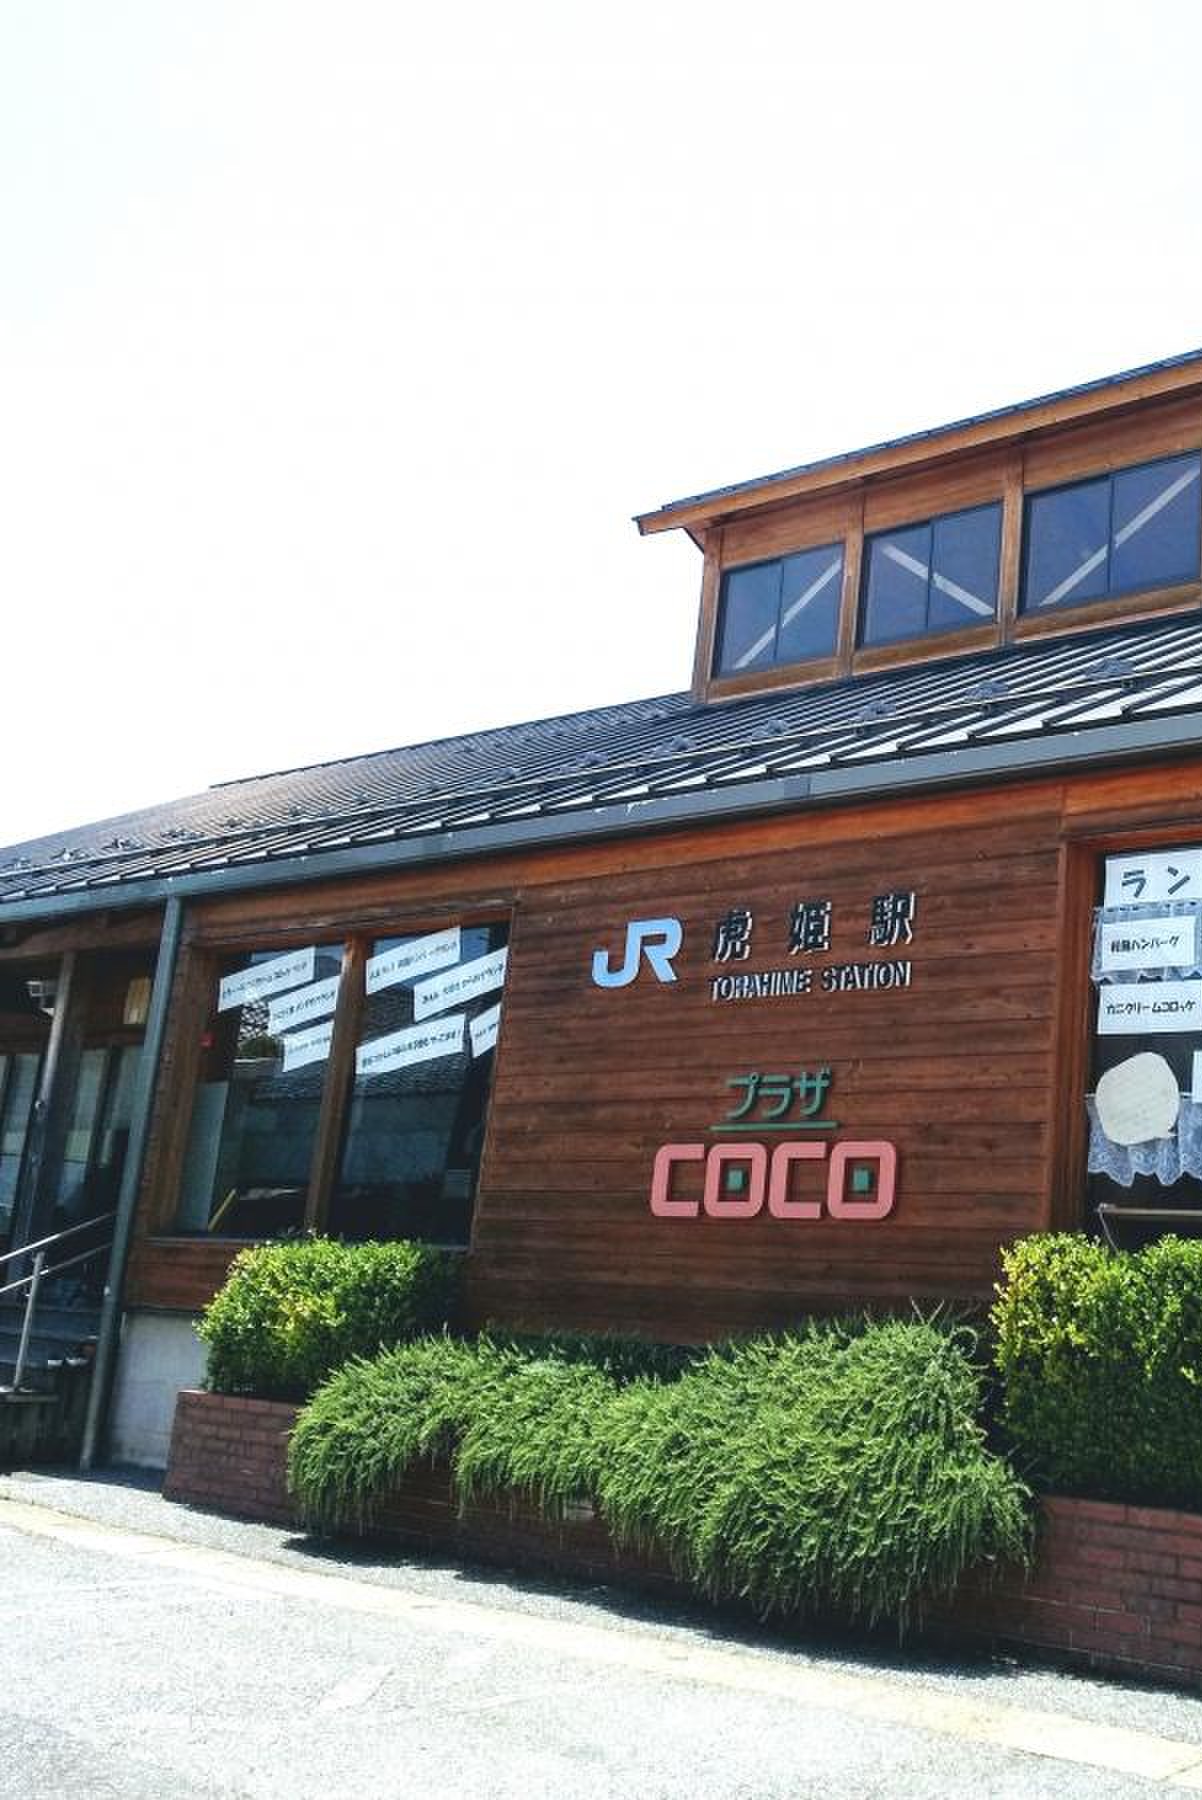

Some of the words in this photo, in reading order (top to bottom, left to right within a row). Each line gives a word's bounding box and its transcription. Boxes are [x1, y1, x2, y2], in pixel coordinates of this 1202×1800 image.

[591, 916, 684, 988] JR
[710, 970, 813, 1001] TORAHIME
[821, 960, 913, 993] STATION
[1106, 999, 1197, 1015] カニクリームコロッケ
[724, 1066, 834, 1120] プラザ
[650, 1140, 897, 1219] COCO
